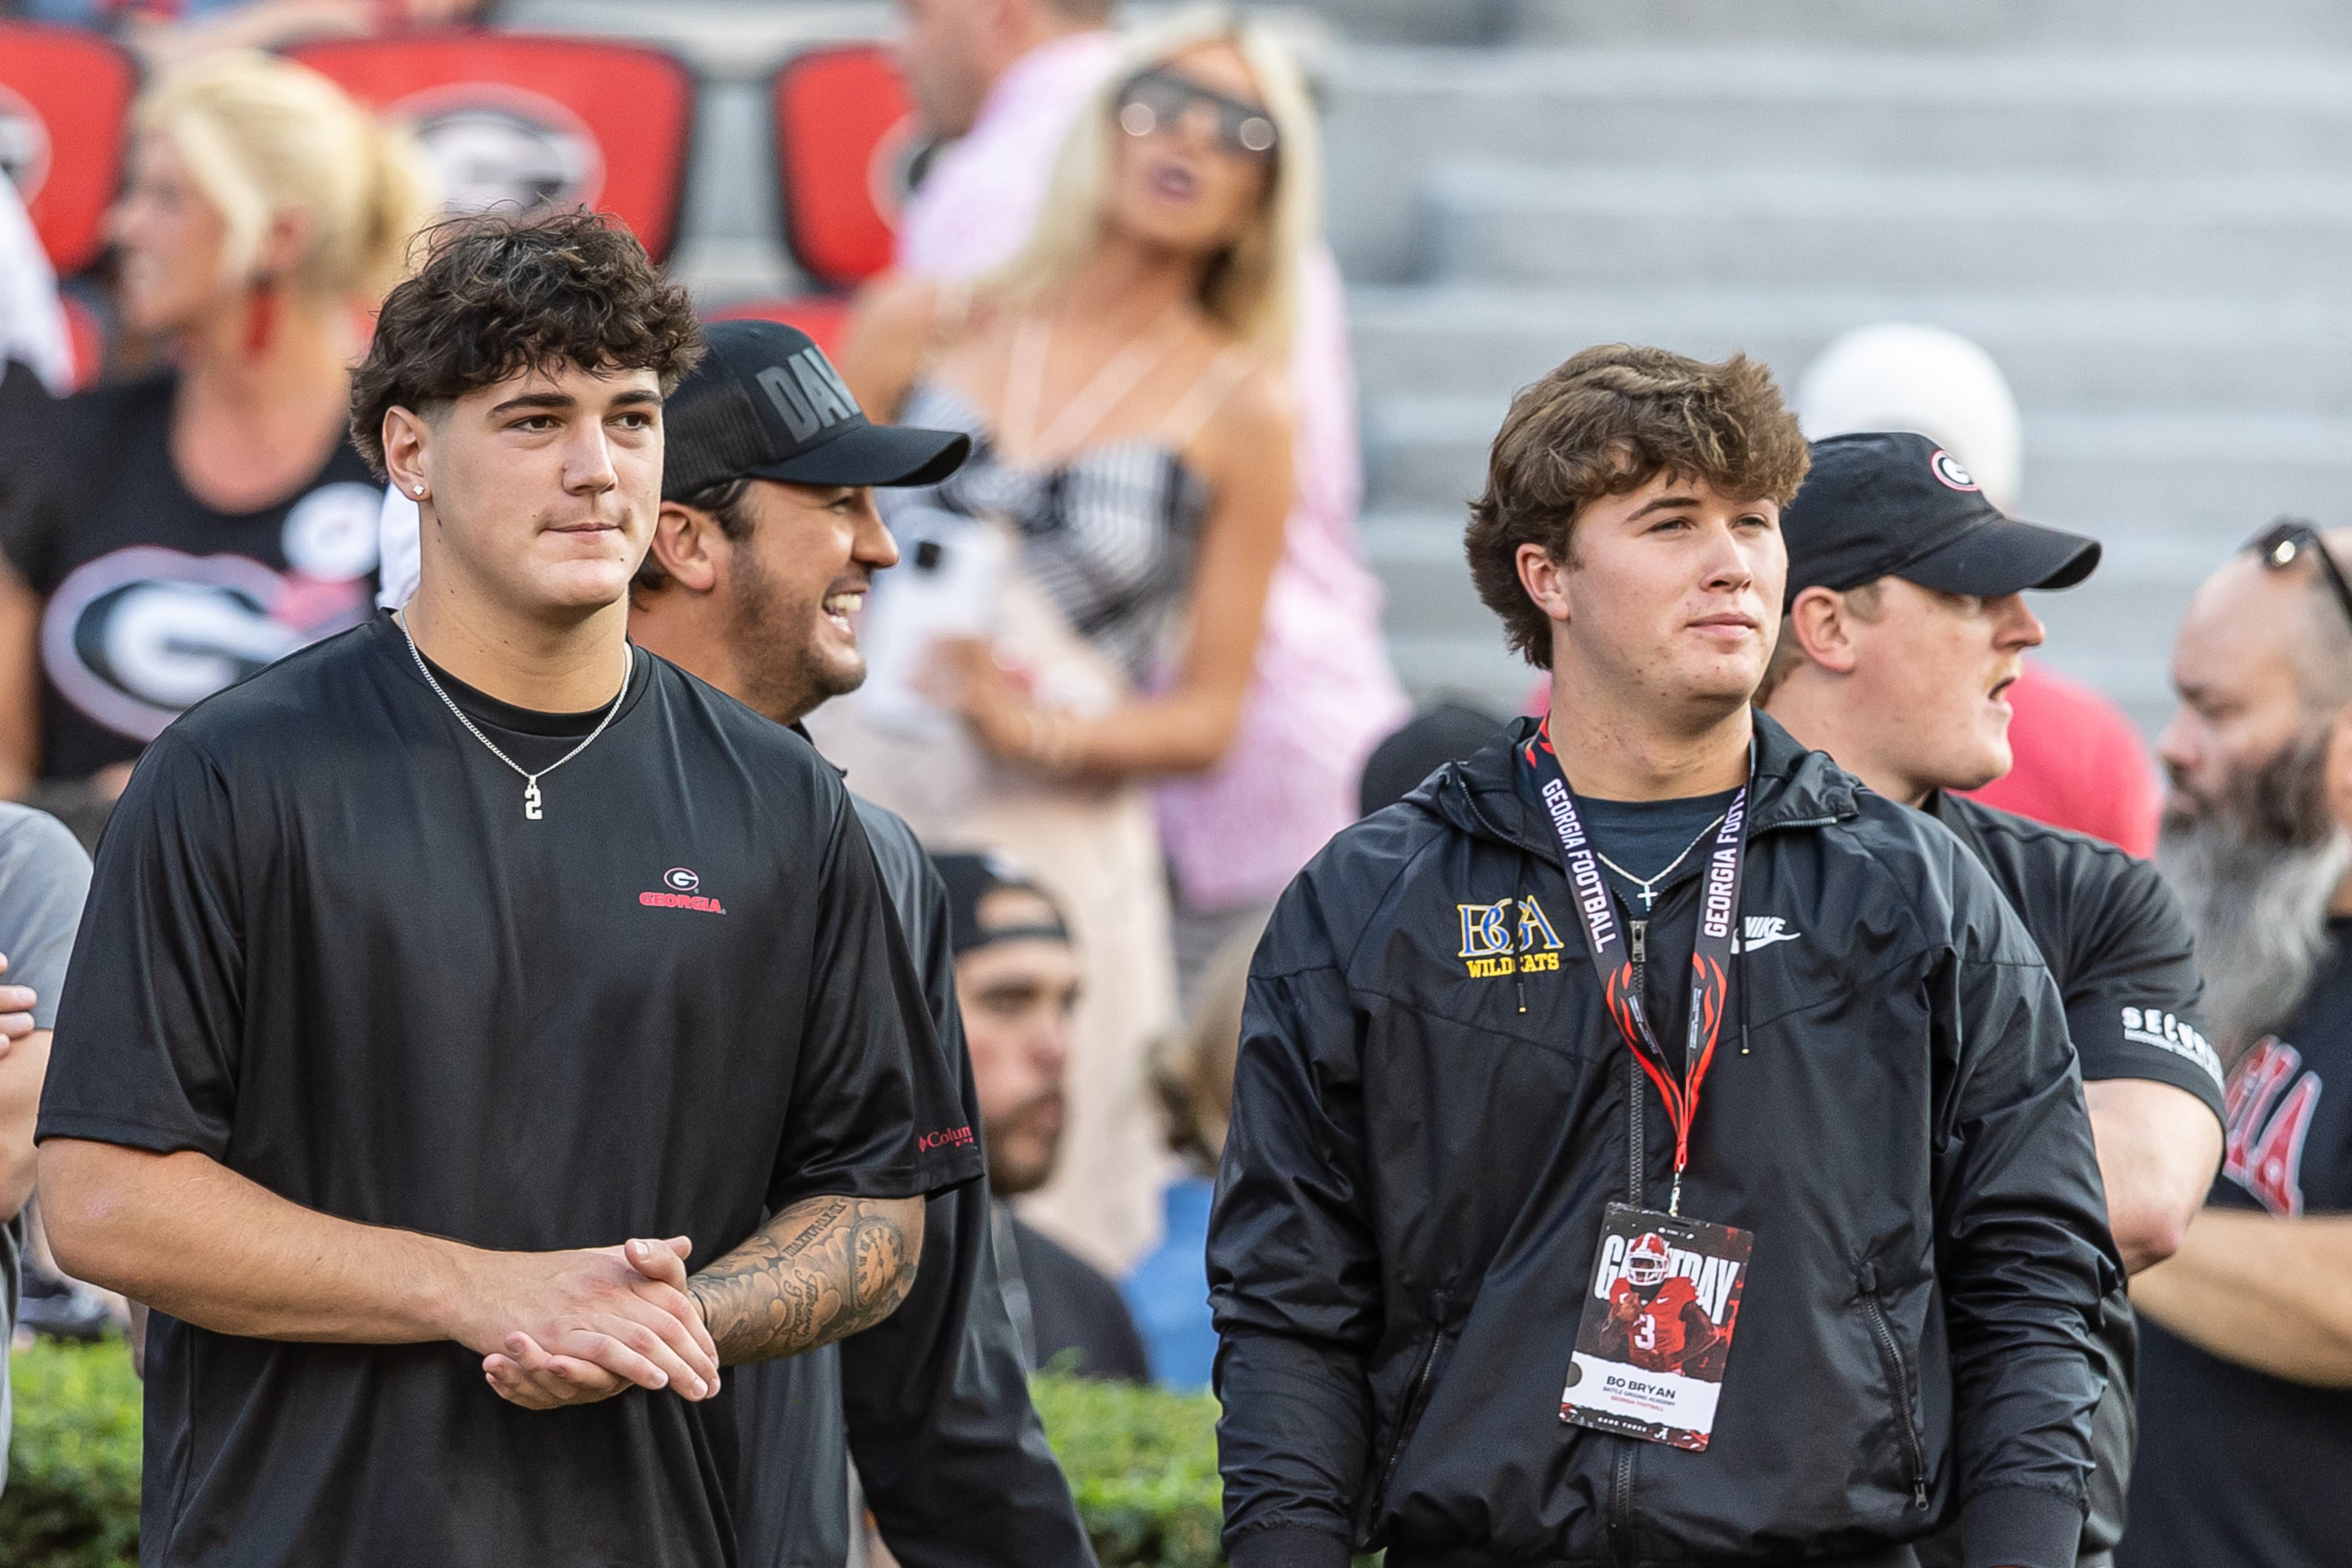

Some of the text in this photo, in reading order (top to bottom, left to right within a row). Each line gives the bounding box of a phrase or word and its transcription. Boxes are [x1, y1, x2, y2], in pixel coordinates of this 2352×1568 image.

[524, 788, 543, 820] 2
[1542, 778, 1616, 953] GEORGIA FOOTBALL
[639, 891, 722, 914] GEORGIA
[1704, 848, 1737, 938] GEORGIA
[1634, 1314, 1656, 1350] 3
[1602, 1386, 1675, 1406] BATTLE GROUND ACADEMY
[1606, 1376, 1676, 1399] BO BRYAN
